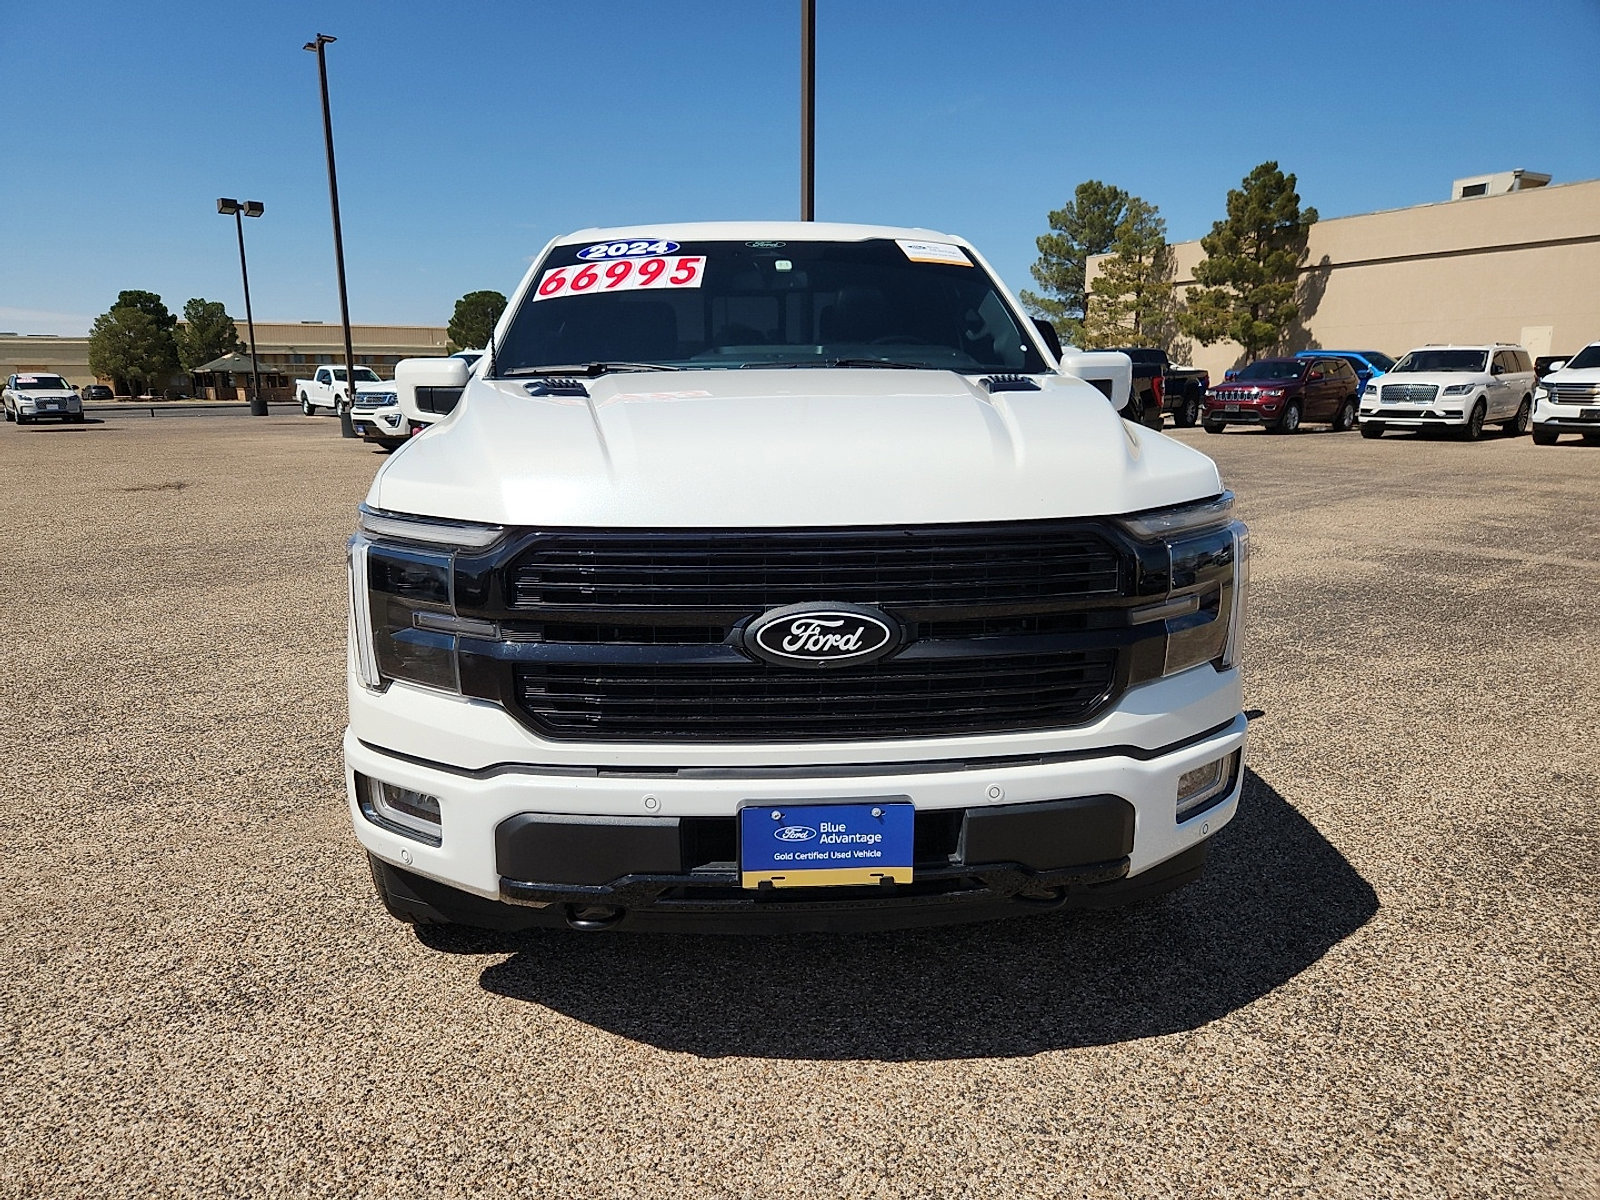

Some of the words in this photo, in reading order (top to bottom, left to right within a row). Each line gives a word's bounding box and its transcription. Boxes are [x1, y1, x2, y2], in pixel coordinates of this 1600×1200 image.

[585, 240, 669, 259] 2024
[538, 257, 701, 296] 66995
[782, 618, 865, 652] Ford
[781, 827, 809, 840] Ford
[819, 822, 846, 833] Blue
[819, 832, 883, 845] Advantage
[773, 851, 794, 861] Gold
[794, 850, 829, 861] Certified
[830, 850, 851, 860] Used
[853, 849, 882, 859] Vehicle
